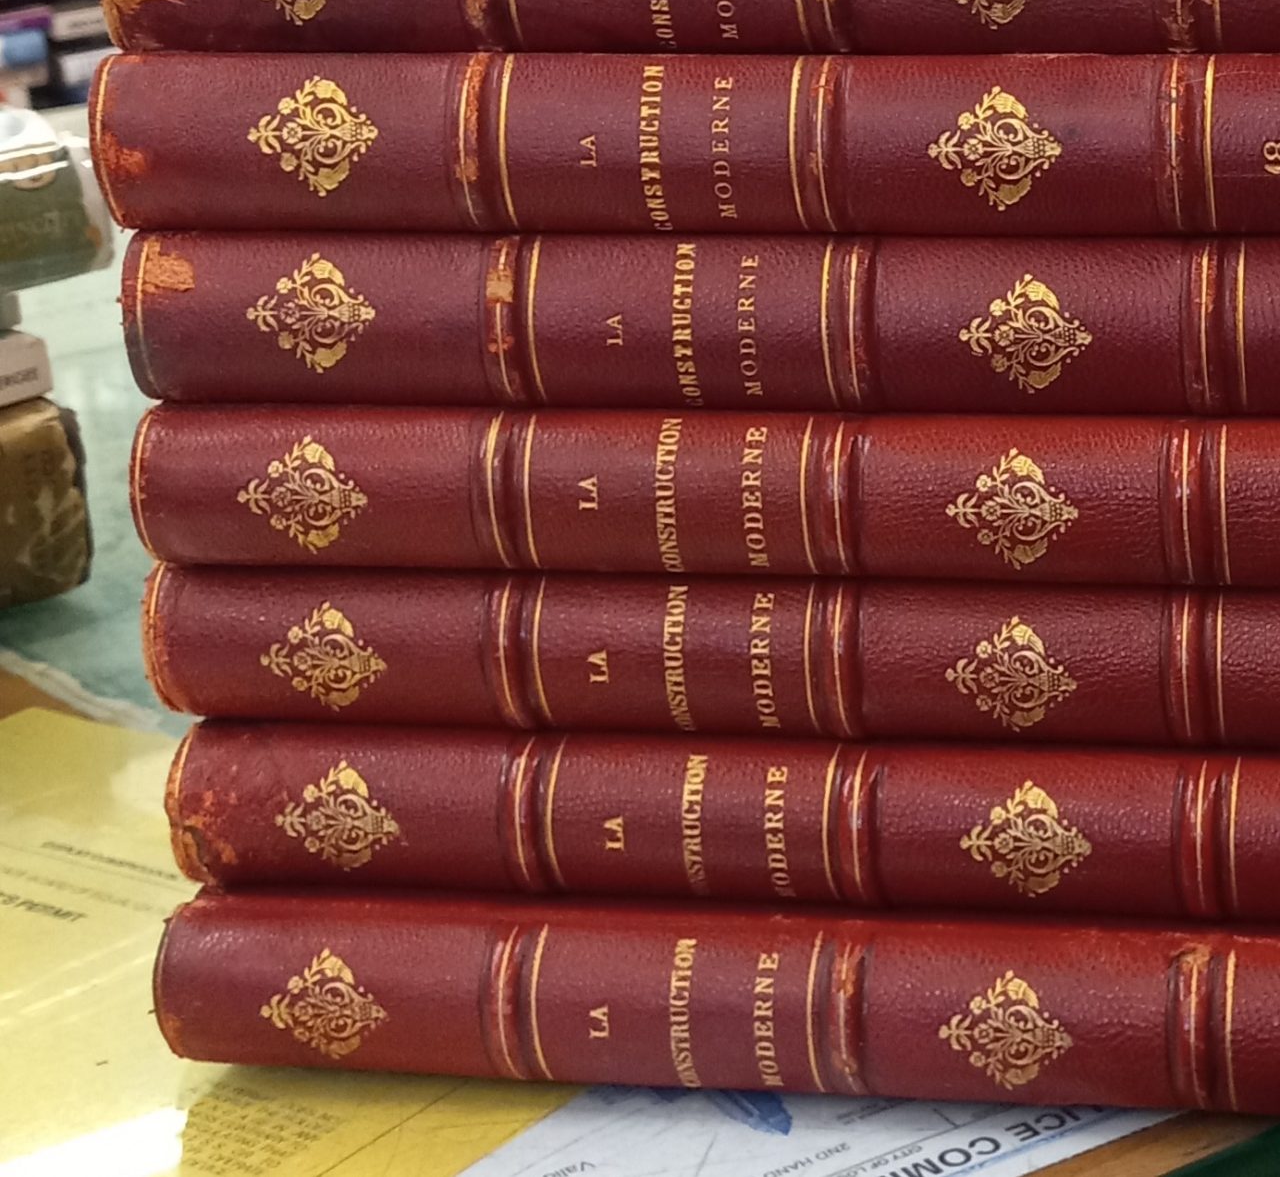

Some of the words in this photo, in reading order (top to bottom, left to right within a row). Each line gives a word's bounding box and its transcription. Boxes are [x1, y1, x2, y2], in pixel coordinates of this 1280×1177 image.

[579, 134, 597, 167] LA
[640, 65, 673, 231] CONSTRUCTION
[712, 77, 737, 219] MODERNE
[606, 313, 623, 346] LA
[738, 255, 763, 396] MODERNE
[578, 475, 598, 510] LA
[655, 417, 684, 573] CONSTRUCTION
[741, 426, 769, 567] MODERNE
[587, 650, 609, 683] LA
[750, 593, 780, 728] MODERNE
[603, 816, 625, 851] LA
[589, 1006, 609, 1039] LA
[754, 952, 784, 1087] MODERNE
[1003, 1104, 1106, 1143] ICE
[814, 1141, 851, 1161] 2ND
[879, 1136, 1001, 1177] COM
